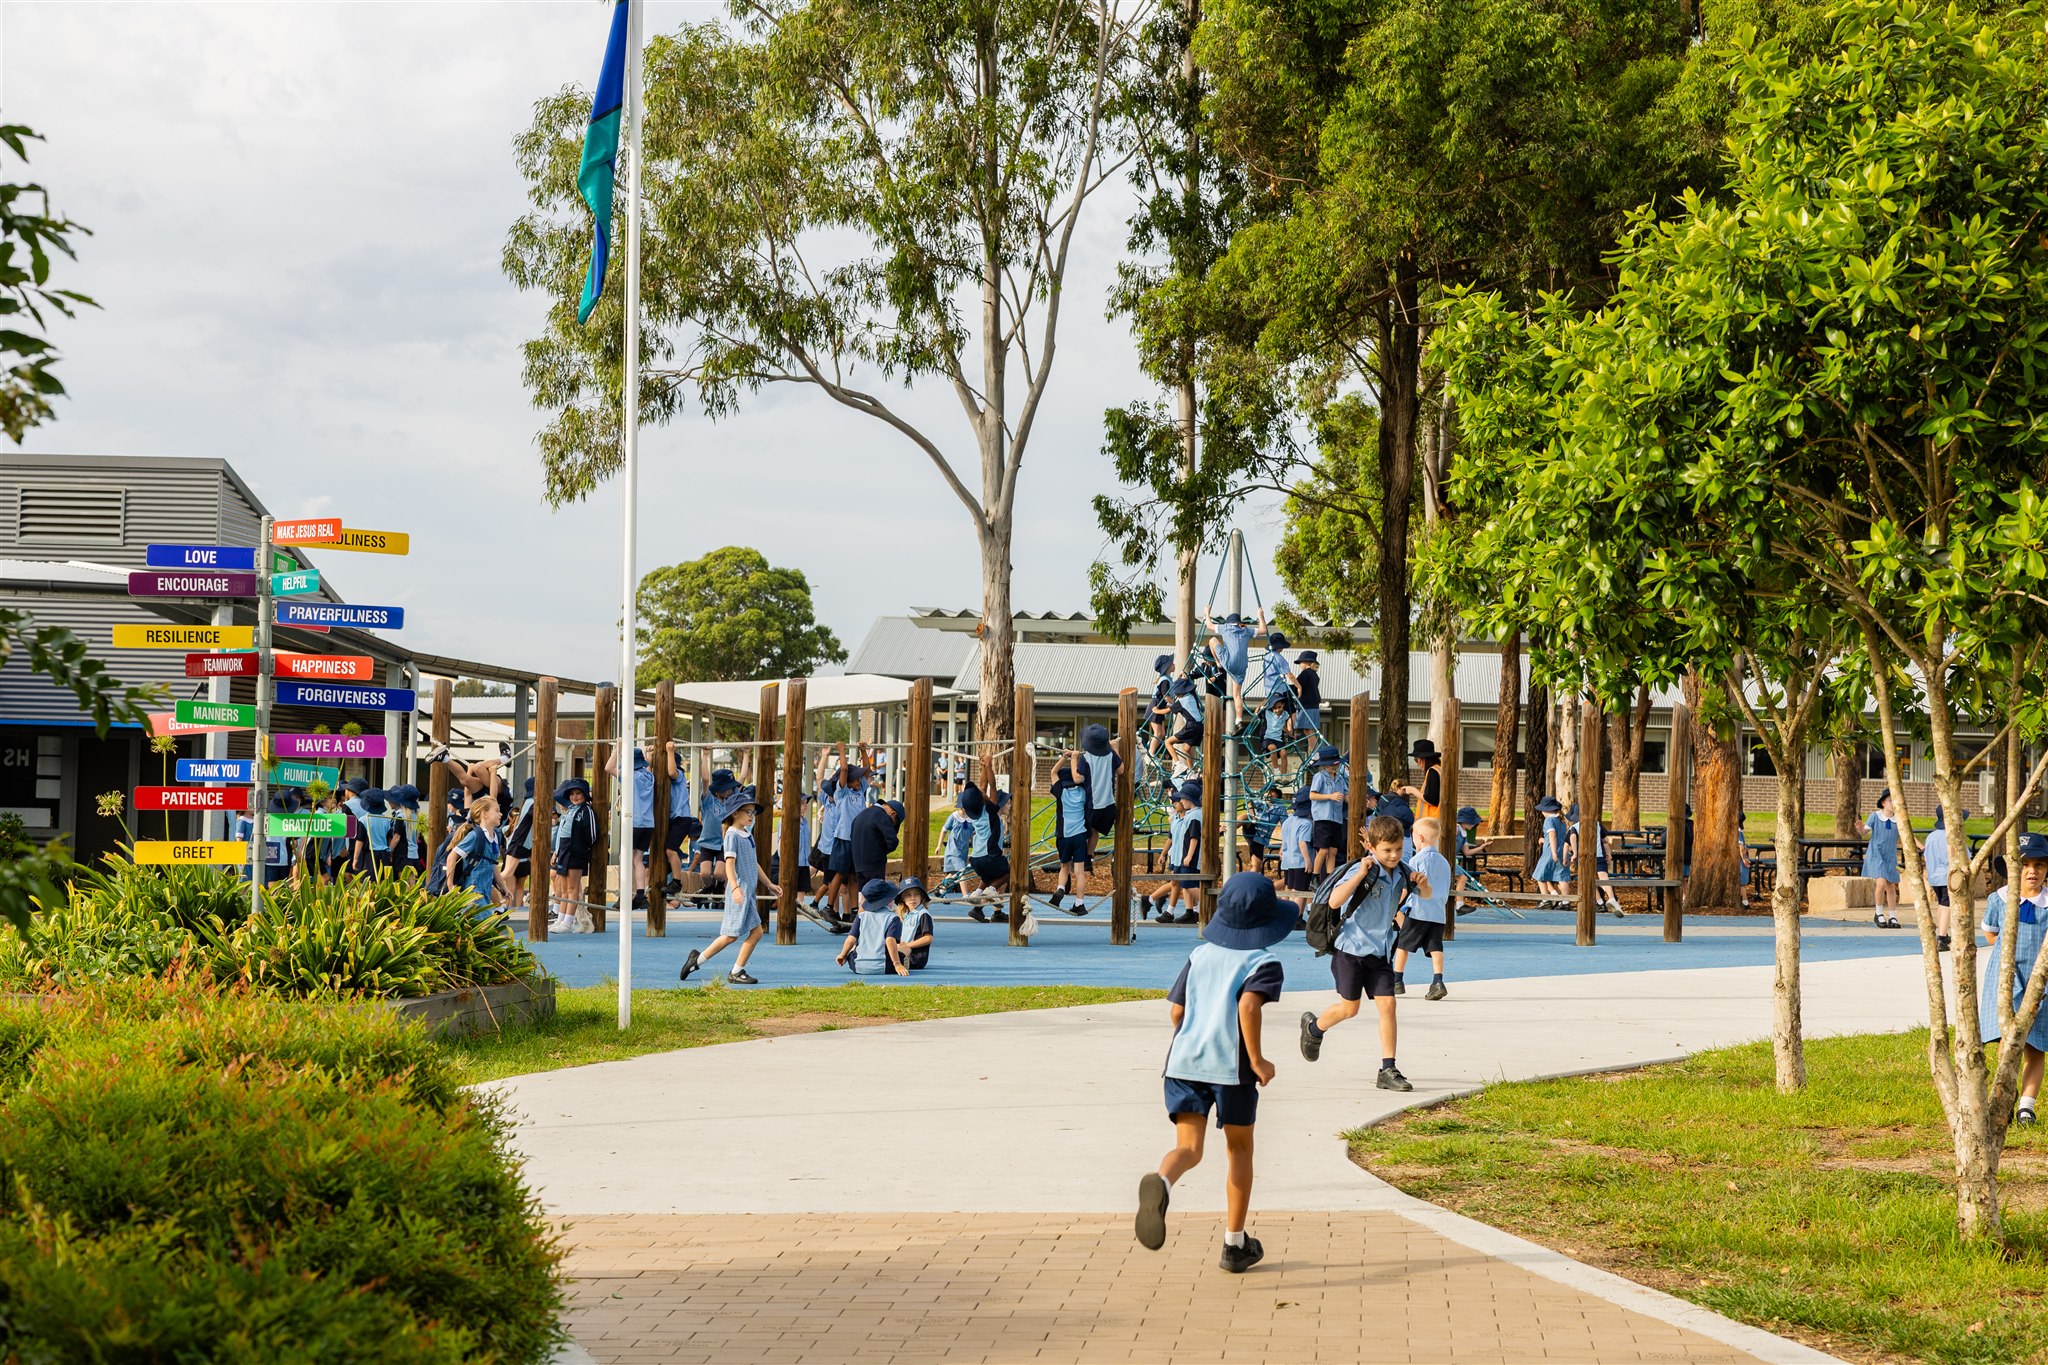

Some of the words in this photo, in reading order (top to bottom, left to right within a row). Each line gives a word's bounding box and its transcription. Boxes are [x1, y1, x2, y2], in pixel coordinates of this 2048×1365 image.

[277, 525, 295, 539] MAKE
[296, 524, 316, 538] JESUS
[318, 523, 334, 537] REAL
[185, 550, 217, 564] LOVE
[157, 578, 228, 592] ENCOURAGE
[282, 576, 307, 591] HELPFUL
[289, 606, 388, 624] PRAYERFULNESS
[146, 630, 220, 643] RESILIENCE
[203, 658, 243, 672] TEAMWORK
[292, 659, 356, 675] HAPPINESS
[297, 687, 386, 706] FORGIVENESS
[193, 706, 239, 722] MANNERS
[295, 739, 330, 752] HAVE
[333, 739, 343, 752] A
[346, 739, 365, 753] GO
[189, 764, 219, 777] THANK
[221, 764, 240, 778] YOU
[161, 792, 223, 806] PATIENCE
[282, 818, 332, 832] GRATITUDE
[173, 846, 214, 859] GREET
